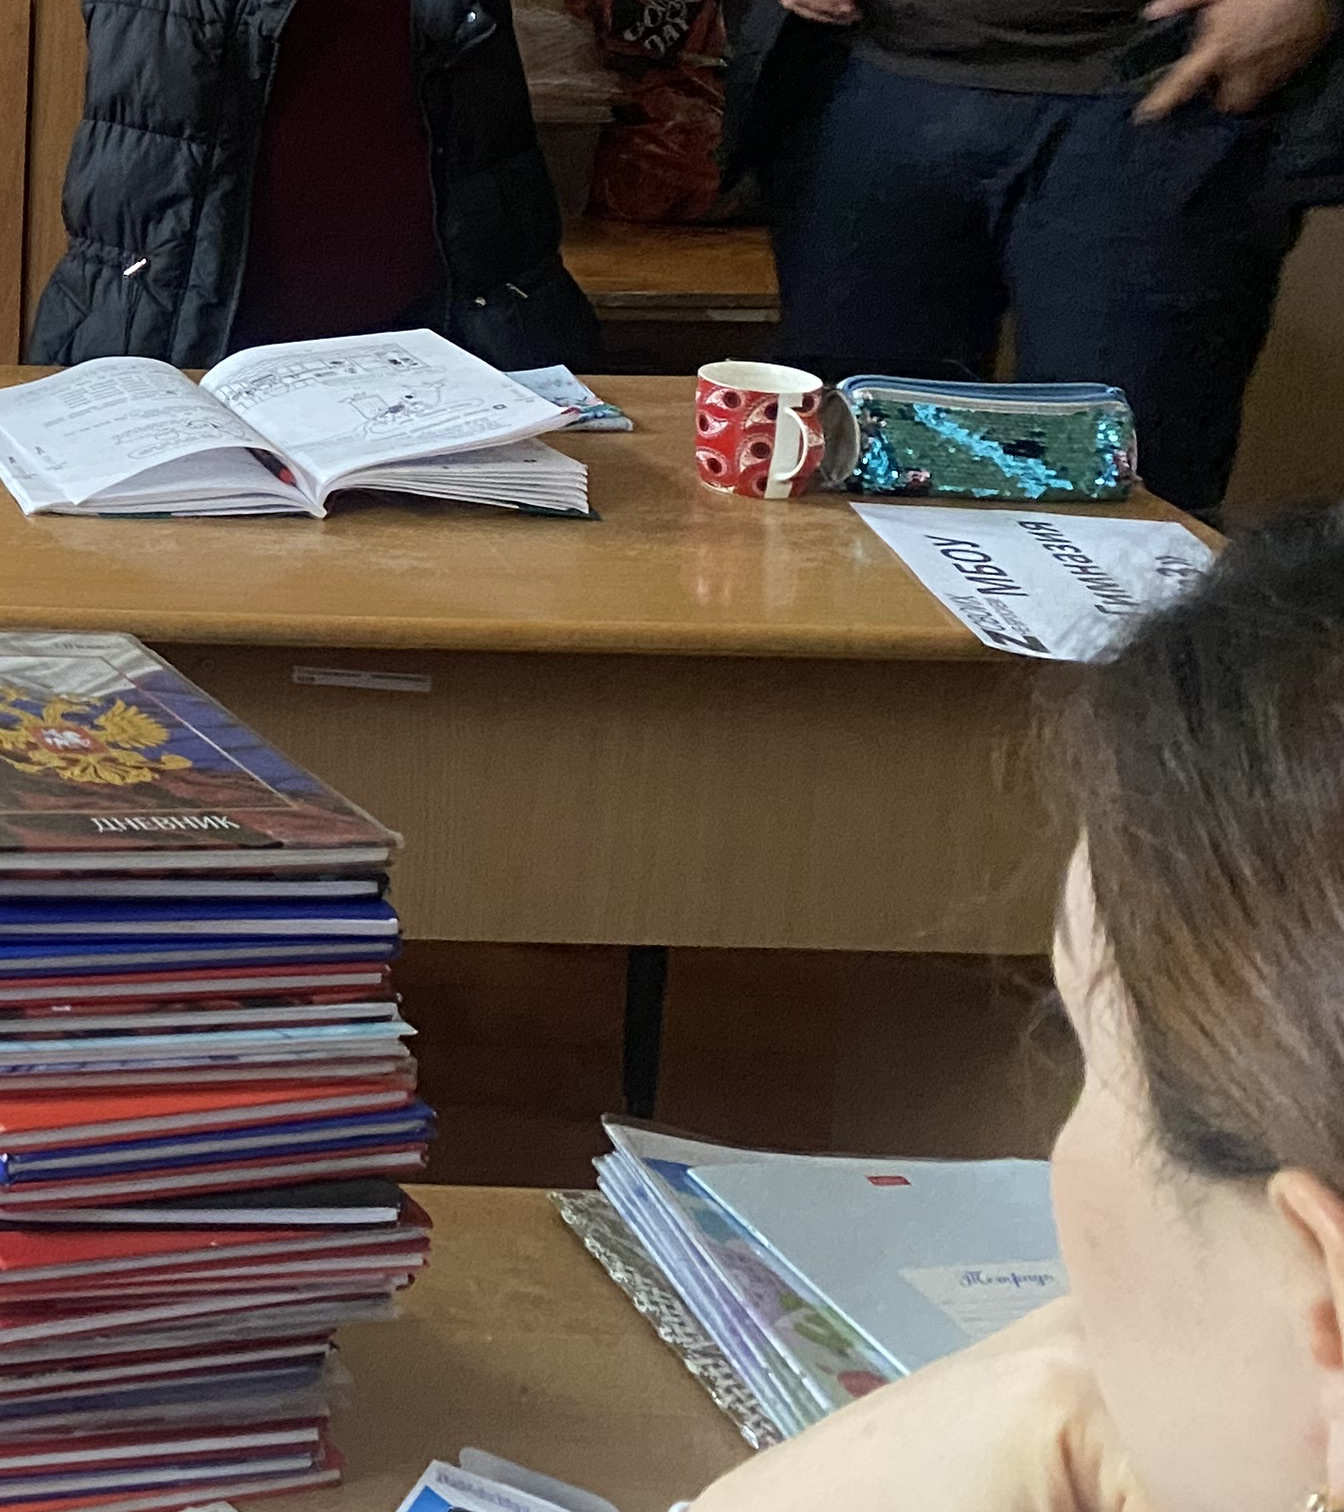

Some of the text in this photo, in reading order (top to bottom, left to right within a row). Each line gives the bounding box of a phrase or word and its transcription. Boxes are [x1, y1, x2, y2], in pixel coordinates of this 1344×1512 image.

[923, 533, 1030, 598] МБОУ
[1016, 520, 1148, 616] Гимназия
[90, 815, 241, 834] ДНЕВНИК
